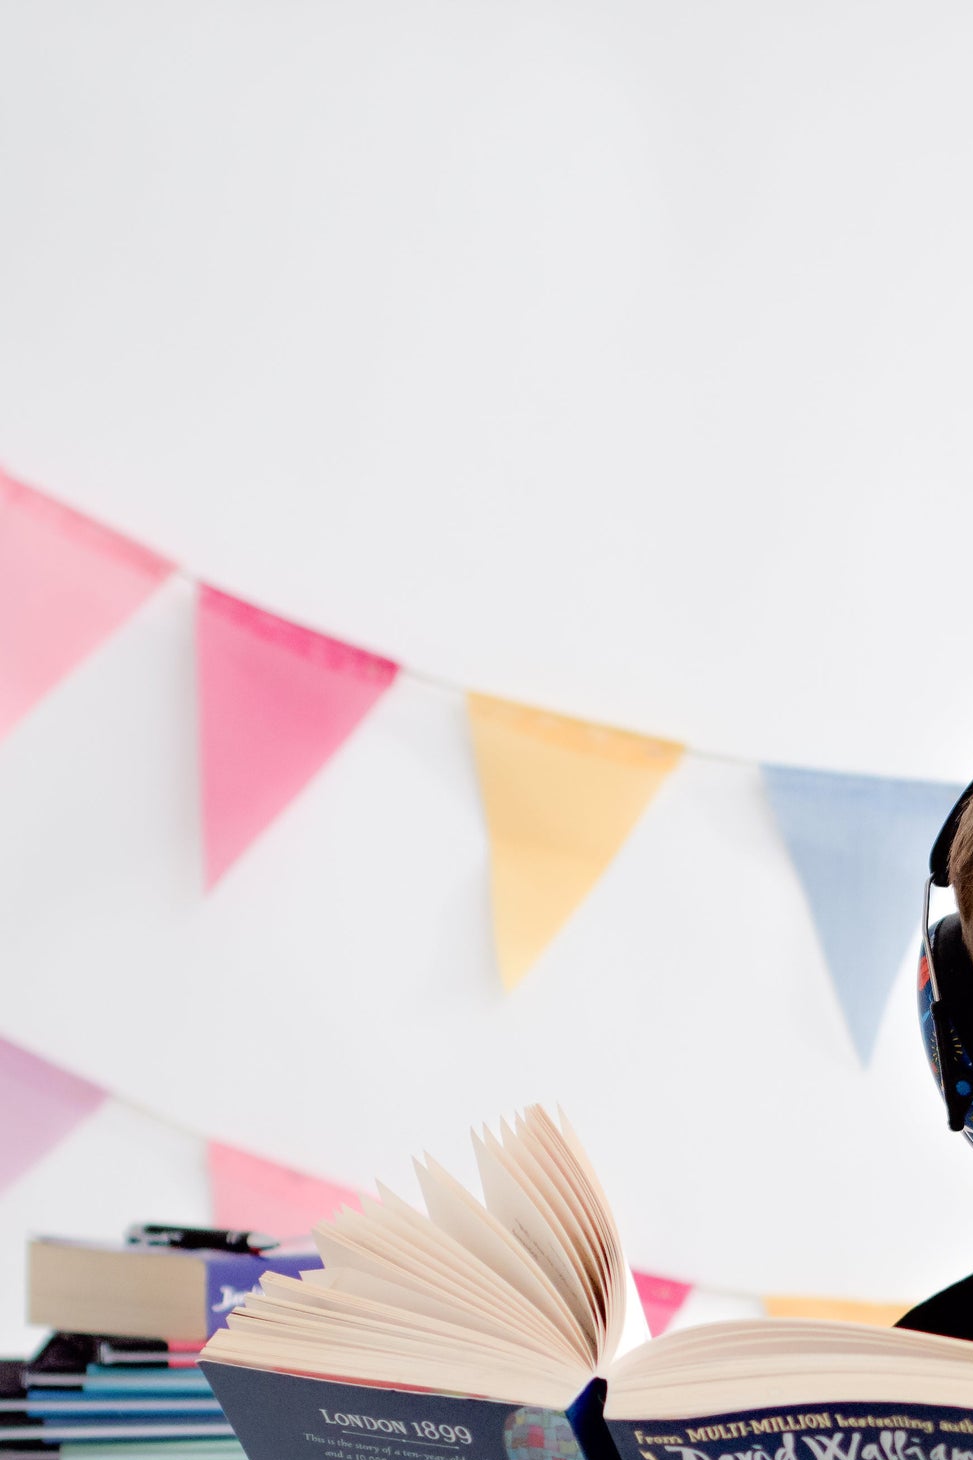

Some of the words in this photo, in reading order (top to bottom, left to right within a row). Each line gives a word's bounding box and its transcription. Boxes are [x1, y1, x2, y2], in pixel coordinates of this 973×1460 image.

[319, 1408, 408, 1435] LONDON
[411, 1420, 473, 1445] 1899
[634, 1430, 683, 1445] From
[686, 1412, 831, 1443] MULTI-MILLION
[835, 1414, 935, 1434] bestselling
[305, 1432, 326, 1444] This
[327, 1437, 335, 1445] is
[337, 1438, 353, 1449] the
[354, 1442, 379, 1454] story
[382, 1445, 391, 1455] of
[324, 1449, 344, 1459] and
